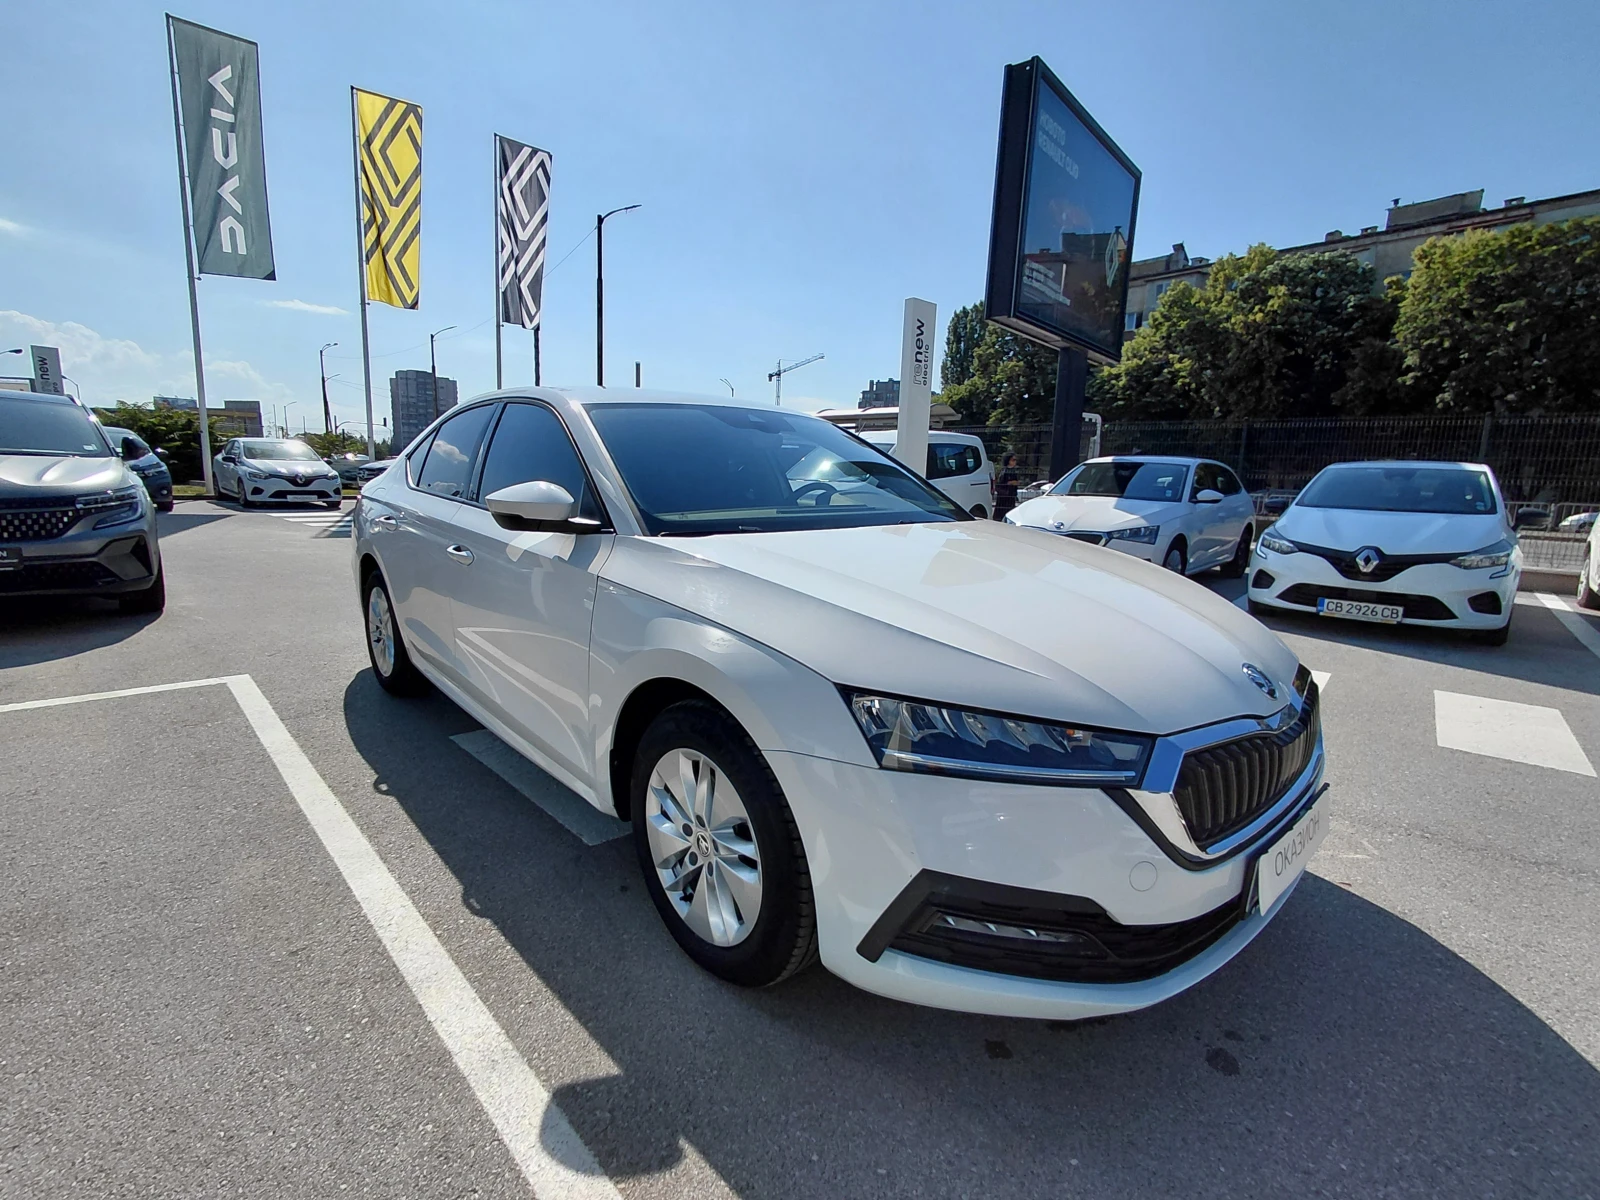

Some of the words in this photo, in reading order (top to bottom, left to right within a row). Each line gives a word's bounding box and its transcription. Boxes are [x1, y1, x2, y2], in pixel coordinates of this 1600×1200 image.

[208, 64, 247, 255] DACIA
[913, 318, 925, 385] renew
[1326, 601, 1343, 613] CB
[1346, 603, 1378, 617] 2926
[1381, 607, 1399, 619] CB
[1275, 811, 1320, 876] ОКАЗИОН
